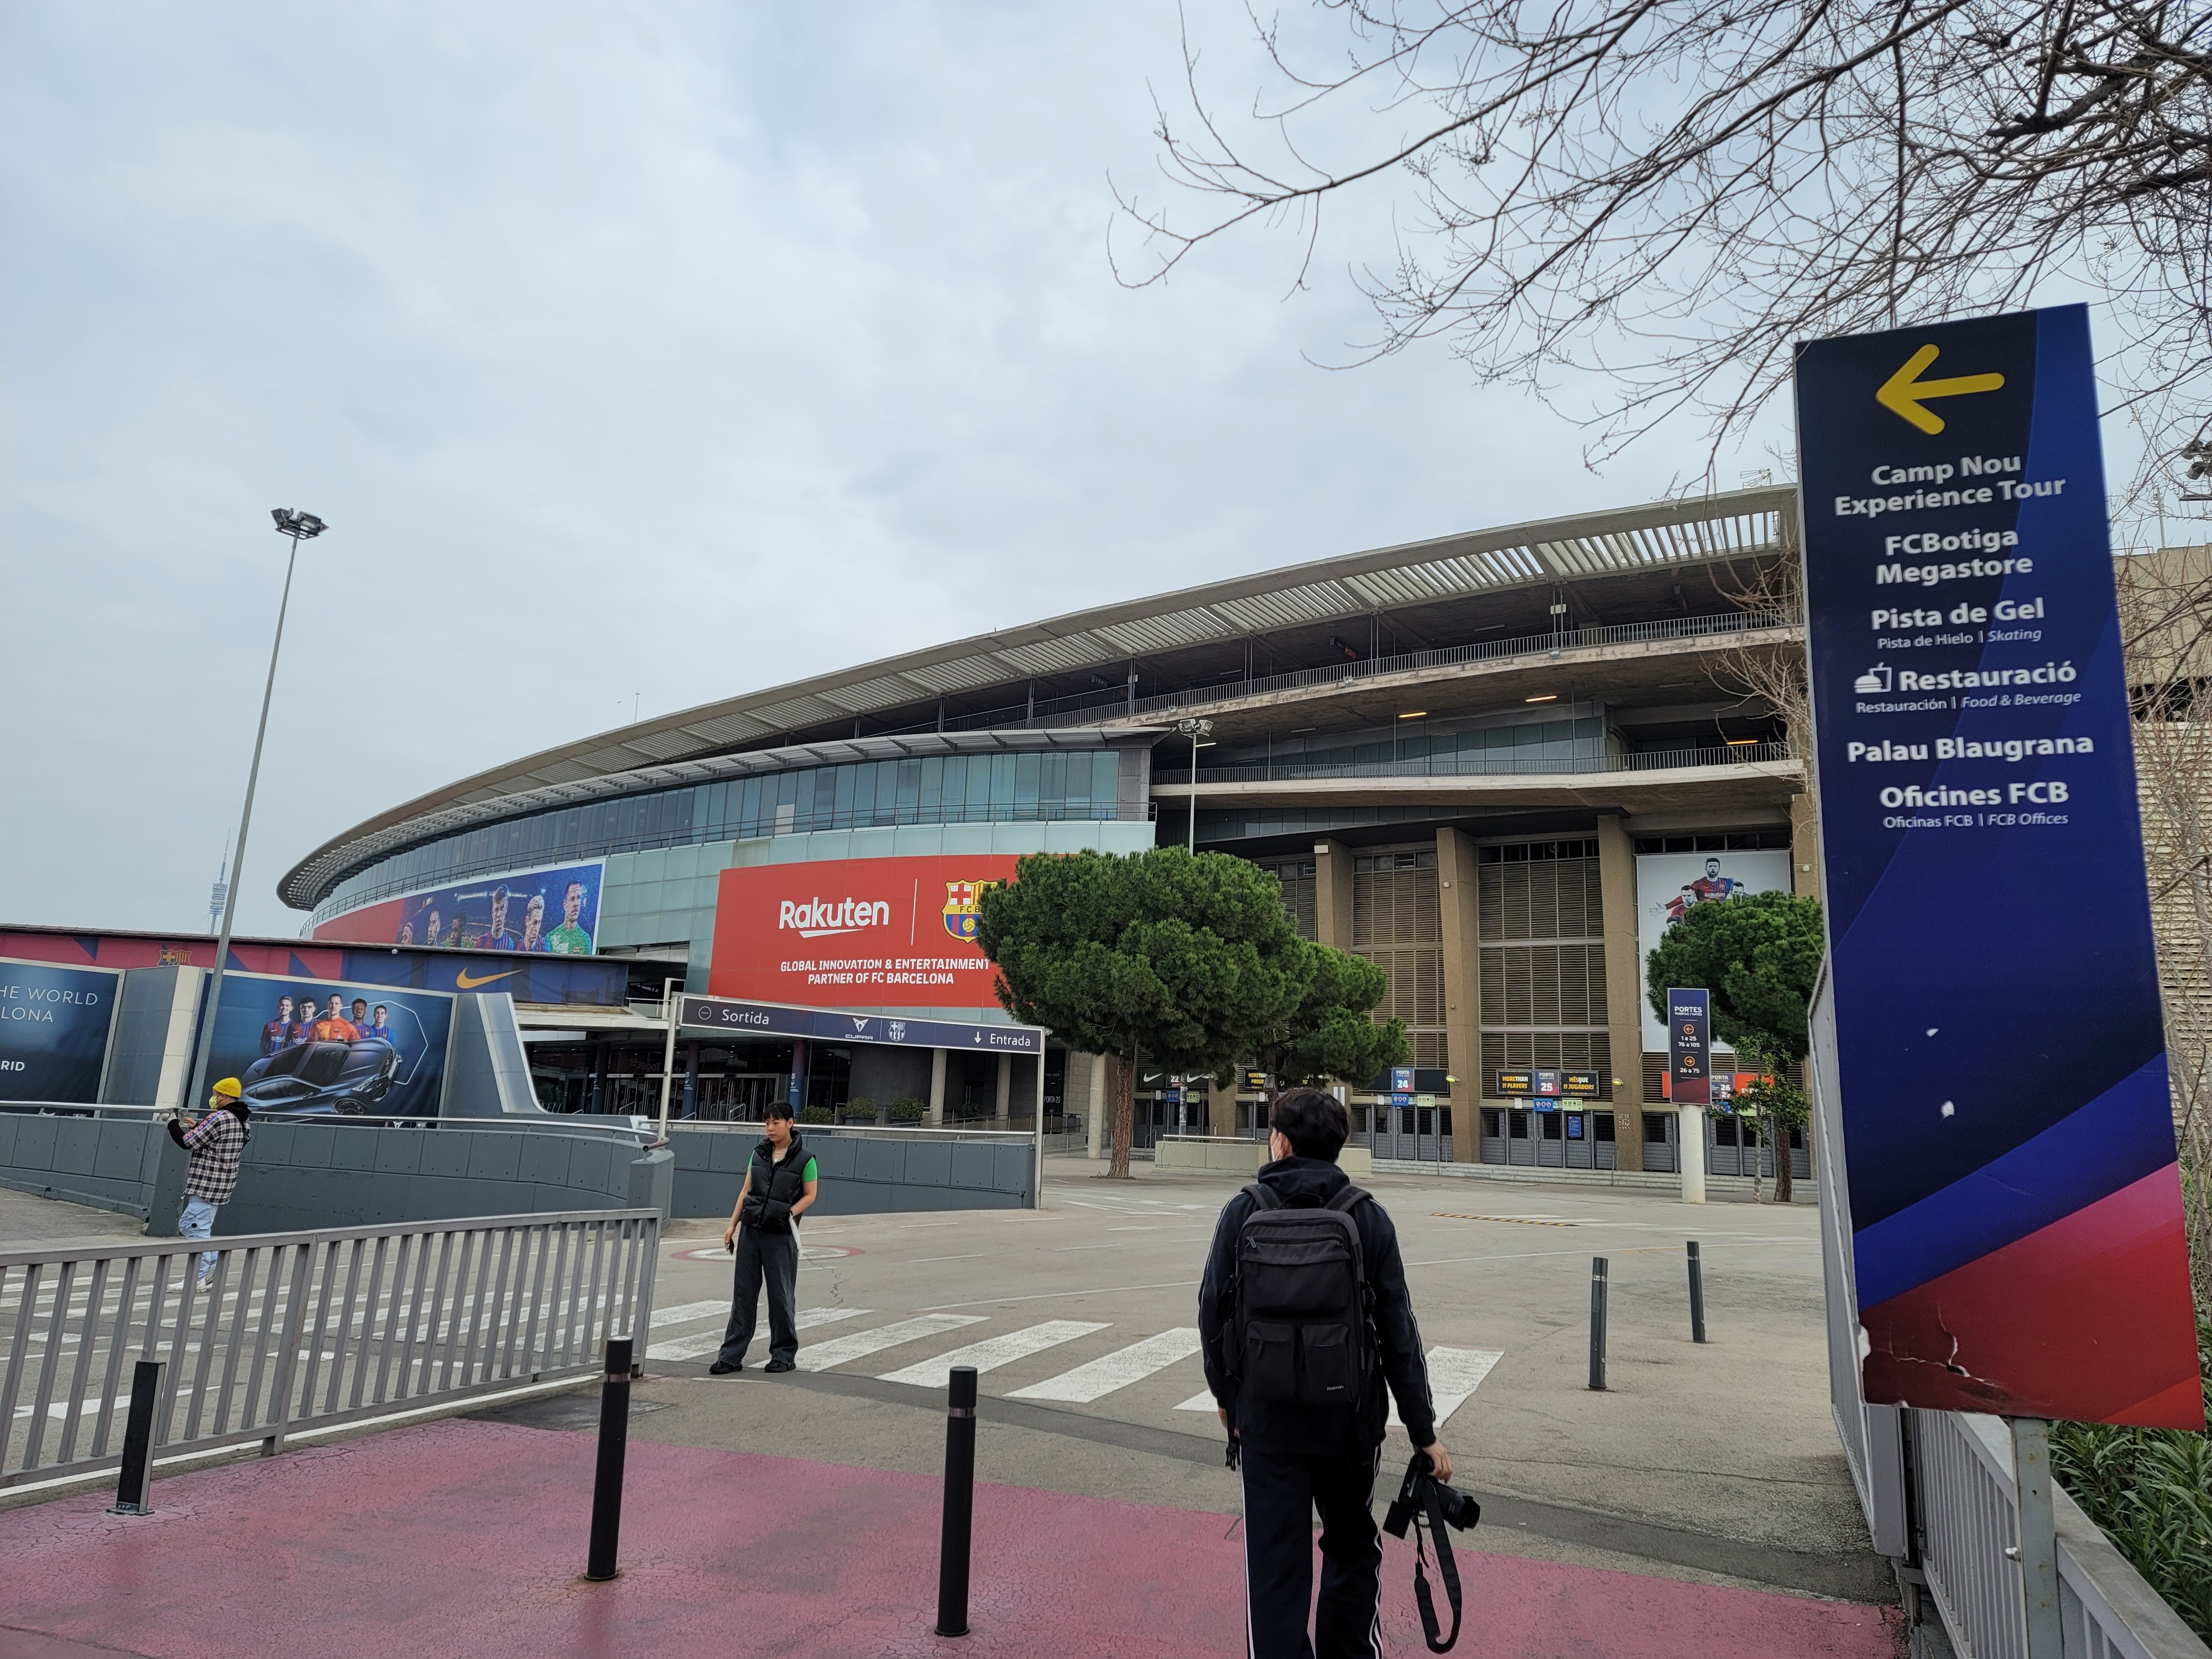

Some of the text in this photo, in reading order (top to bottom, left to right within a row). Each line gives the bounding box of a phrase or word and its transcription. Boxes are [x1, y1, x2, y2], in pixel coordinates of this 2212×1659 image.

[1871, 456, 2021, 486] Camp Nou
[1835, 478, 2066, 518] Experience Tour
[1885, 528, 2018, 556] FCBotiga
[1876, 557, 2033, 586] Megastore
[1871, 597, 2044, 630] Pista de Gel
[1877, 637, 1911, 649] Pista
[1913, 634, 1932, 647] de
[1935, 632, 1974, 645] Hielo
[1987, 629, 2042, 643] Skating
[1899, 660, 2077, 691] Restauració
[1855, 698, 1948, 713] Restauración
[1960, 694, 1997, 708] Food
[2000, 694, 2012, 707] &
[2015, 692, 2081, 706] Beverage
[1847, 736, 2094, 763] Palau Blaugrana
[1880, 781, 2069, 808] Oficines FCB
[1884, 815, 1942, 828] Oficinas
[1944, 815, 1973, 827] FCB
[1987, 813, 2016, 826] FCB
[2018, 812, 2069, 825] Offices
[779, 897, 889, 929] Rakuten
[780, 958, 990, 972] GLOBAL INNOVATION & ENTERTAINMENT
[808, 972, 954, 984] PARTNER OF FC BARCELONA
[28, 987, 97, 1005] WORLD
[1, 1006, 54, 1022] LONA
[721, 1009, 769, 1025] Sortida
[990, 1034, 1031, 1047] Entrada
[1, 1060, 25, 1071] RID
[1541, 1083, 1553, 1092] 25
